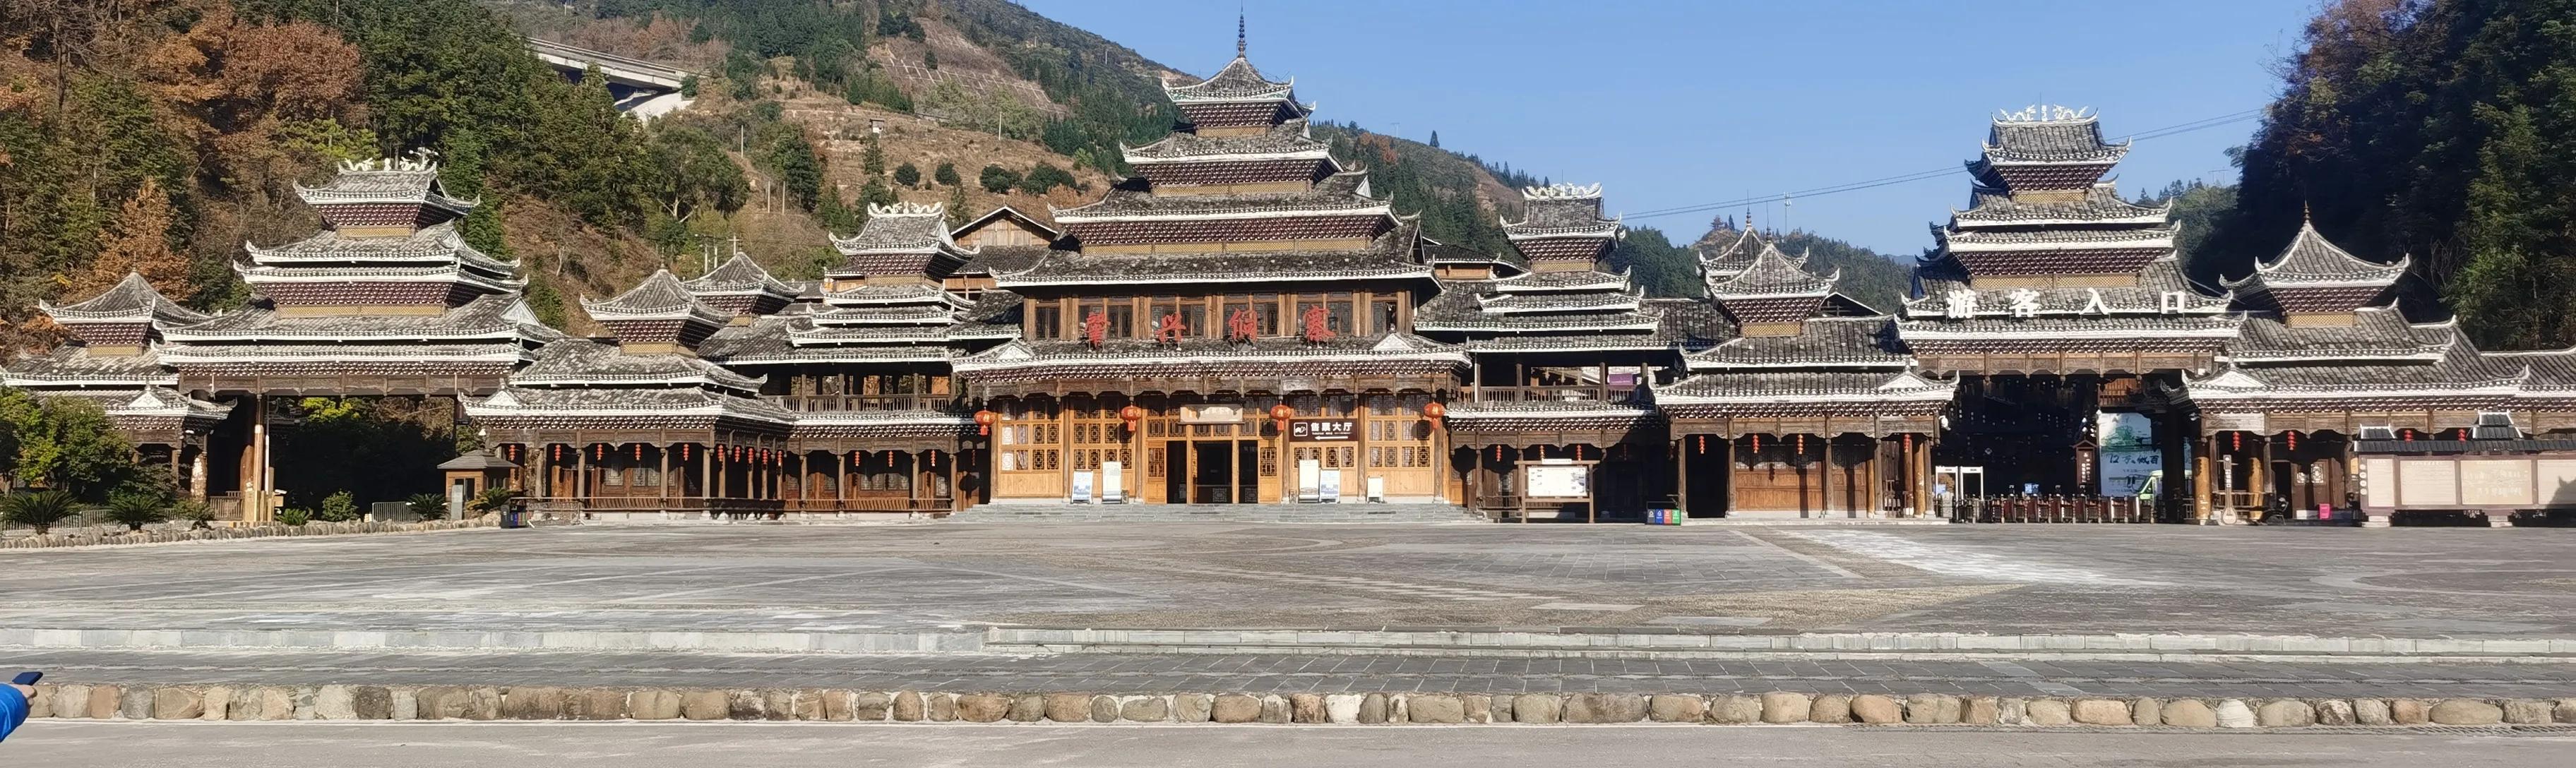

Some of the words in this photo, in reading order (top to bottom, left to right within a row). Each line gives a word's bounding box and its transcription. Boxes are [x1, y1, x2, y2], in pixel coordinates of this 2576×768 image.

[1947, 288, 2185, 318] 游客入口
[1311, 421, 1352, 432] 售票大厅
